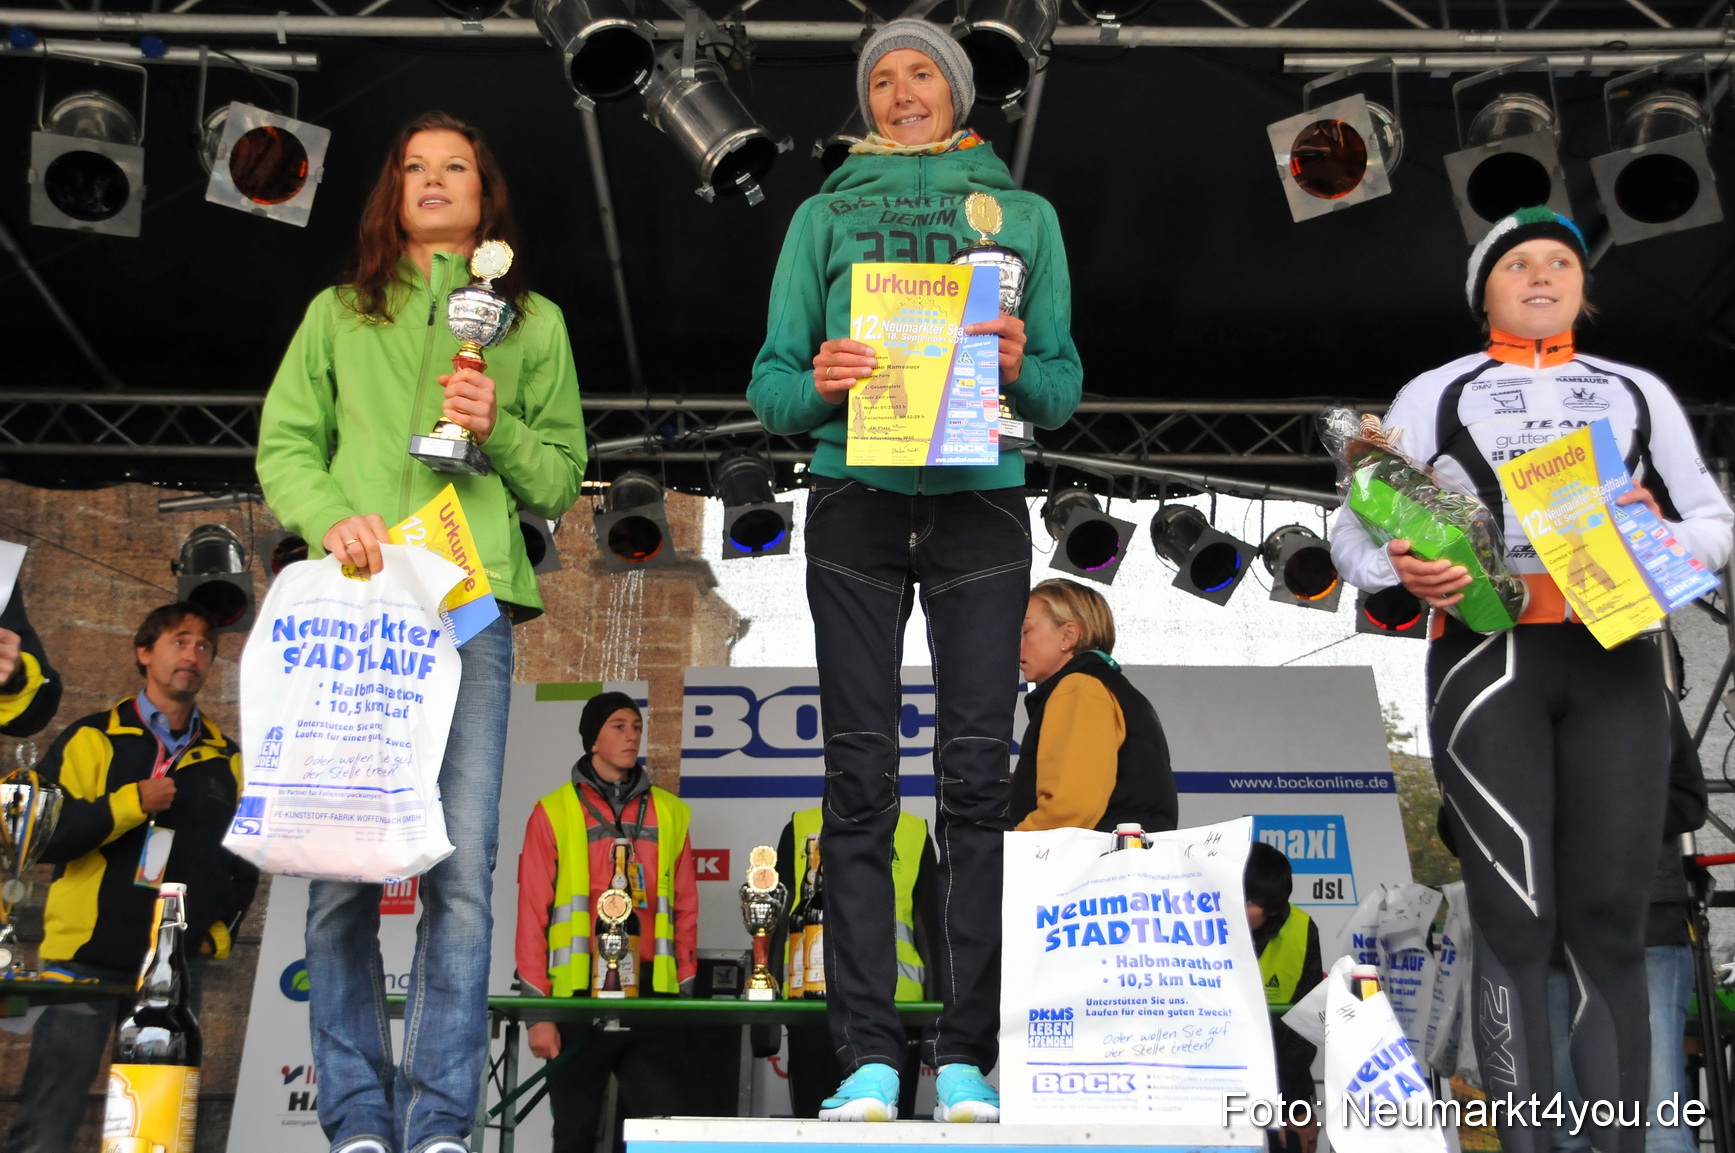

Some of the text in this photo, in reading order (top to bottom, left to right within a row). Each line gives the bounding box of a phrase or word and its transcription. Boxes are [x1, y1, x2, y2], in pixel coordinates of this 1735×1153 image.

[878, 209, 958, 228] DENIM
[865, 273, 960, 297] Urkunde
[852, 314, 882, 341] 12.
[881, 319, 945, 335] Neumarkter
[887, 332, 969, 344] 18. September 2011
[1510, 445, 1587, 491] Urkunde
[1544, 492, 1592, 521] Neumarkter
[1590, 470, 1629, 499] Stadtlauf
[439, 501, 477, 593] Urkunde
[329, 699, 362, 717] 10,5
[364, 699, 385, 713] km
[295, 730, 324, 739] Laufen
[326, 730, 340, 741] für
[342, 734, 367, 742] einen
[329, 765, 361, 780] Stelle
[1228, 775, 1389, 789] www.bockonline.de
[274, 810, 355, 822] PE-KUNSTSTOFF-FABRIK
[1259, 823, 1336, 860] maxi
[1312, 878, 1344, 900] dsl
[1036, 888, 1222, 929] Neumarkter
[1045, 917, 1229, 952] STADTLAUF
[1115, 953, 1234, 970] Halbmarathon
[1117, 972, 1222, 990] 10,5 km Lauf
[1086, 996, 1189, 1006] Unterstützen Sie uns.
[1028, 1007, 1075, 1021] DKMS
[1086, 1007, 1232, 1018] Laufen für einen guten Zweck!
[1028, 1021, 1074, 1036] LEBEN
[1102, 1021, 1231, 1046] Oder wollen Sie auf
[1028, 1035, 1074, 1048] SPENDEN
[1104, 1037, 1214, 1059] der Stelle treten?
[1032, 1072, 1136, 1094] BOCK
